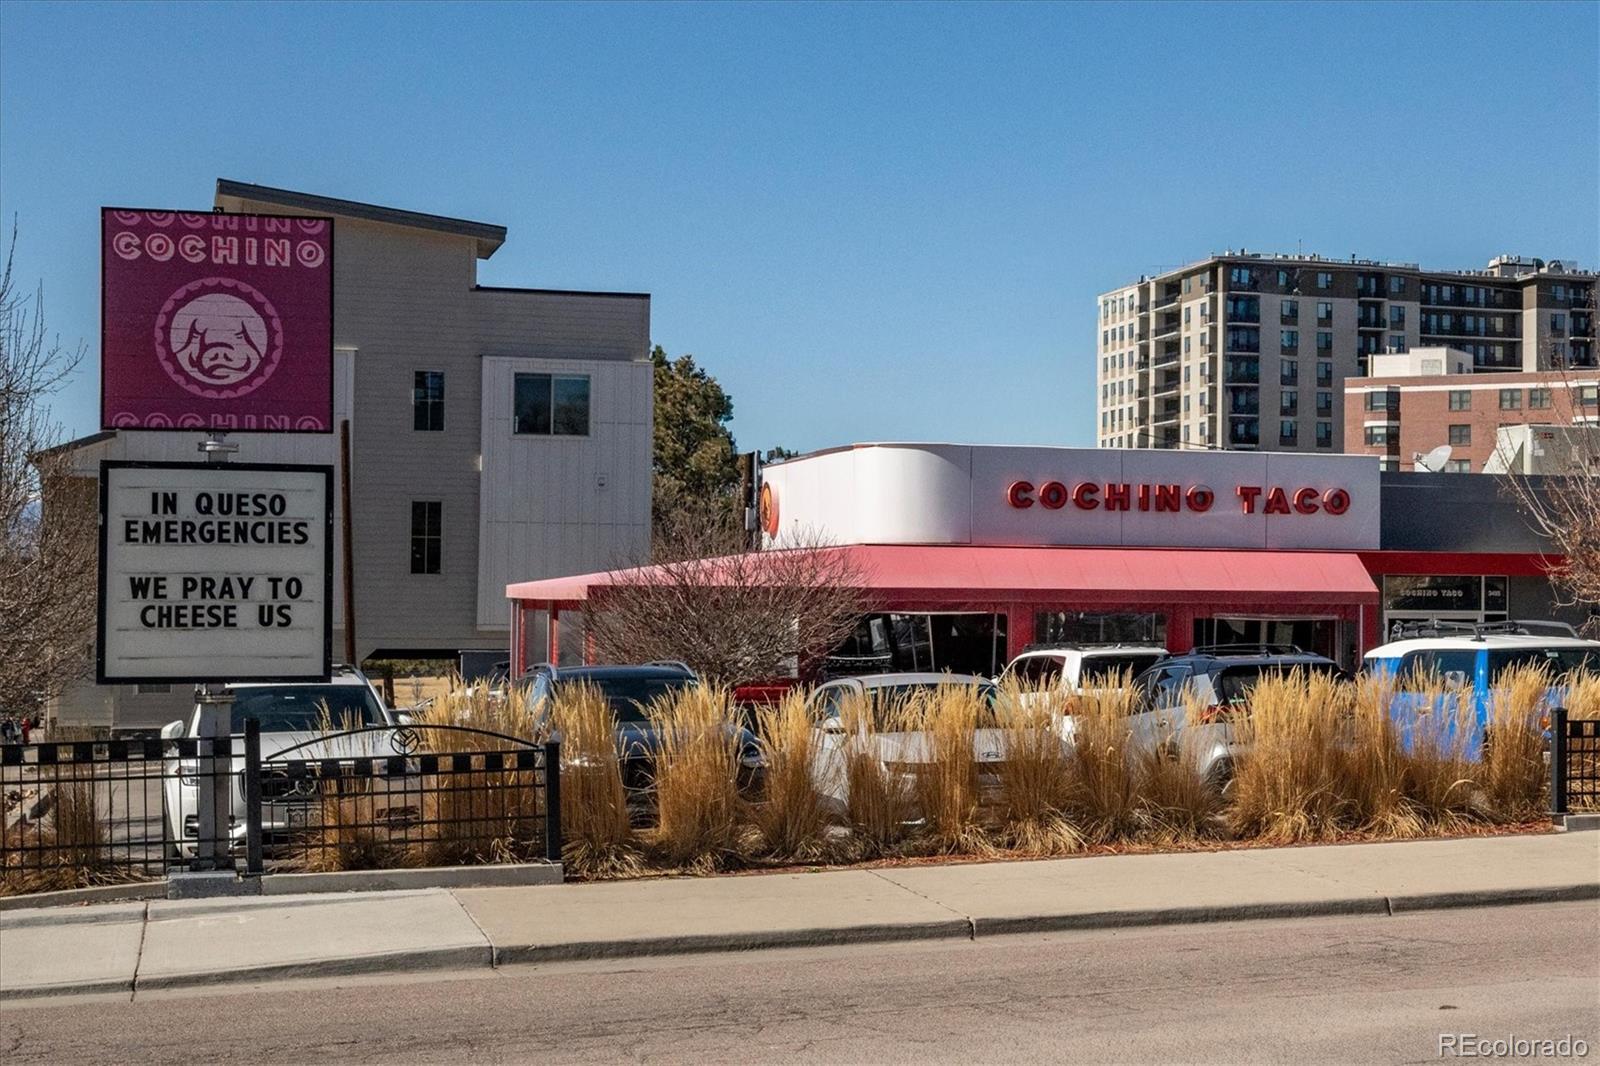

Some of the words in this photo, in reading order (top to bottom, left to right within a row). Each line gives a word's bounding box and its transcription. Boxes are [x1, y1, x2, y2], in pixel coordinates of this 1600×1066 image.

[113, 231, 325, 268] COCHINO
[151, 492, 178, 515] IN
[195, 492, 287, 517] QUESO
[1007, 480, 1215, 513] COCHINO
[1236, 485, 1352, 516] TACO
[124, 520, 309, 545] EMERGENCIES
[129, 576, 168, 600] WE
[182, 576, 255, 600] PRAY
[268, 577, 303, 600] TO
[140, 604, 238, 628] CHEESE
[258, 604, 292, 628] US
